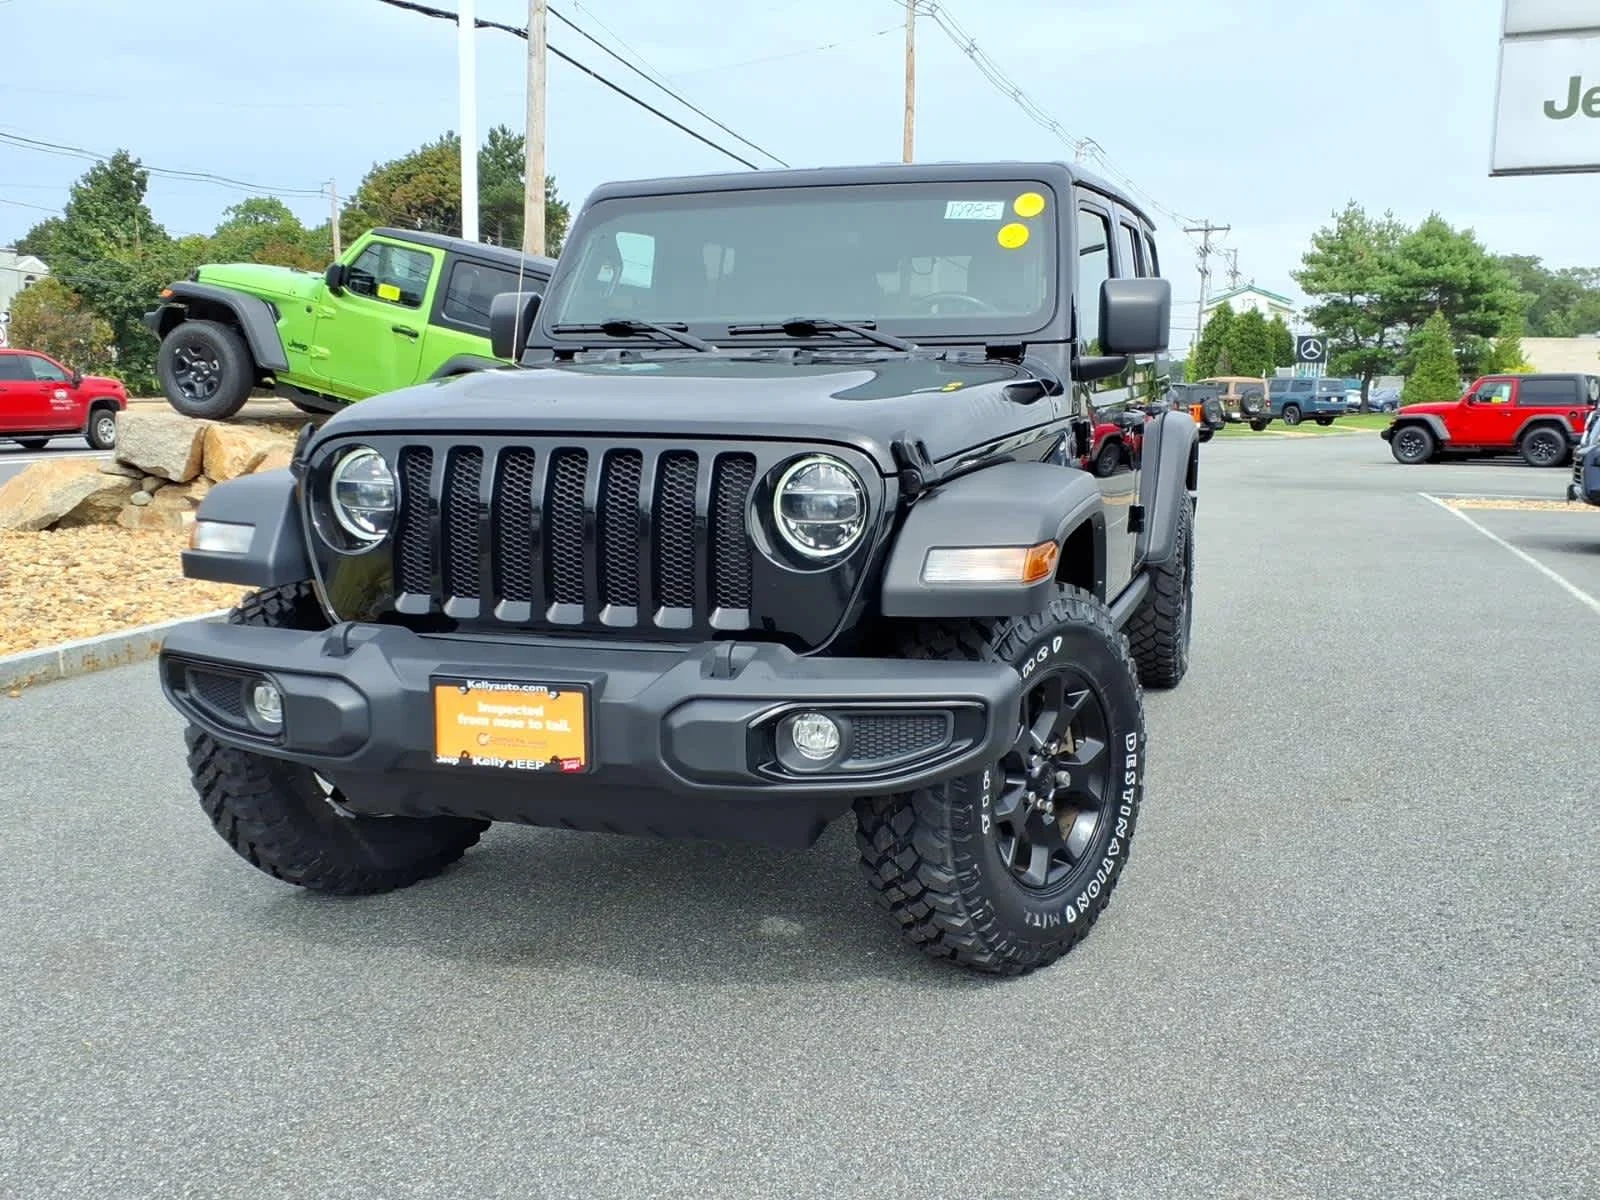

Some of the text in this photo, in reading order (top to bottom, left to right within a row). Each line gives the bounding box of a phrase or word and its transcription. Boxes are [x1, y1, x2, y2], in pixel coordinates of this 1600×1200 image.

[466, 680, 548, 693] Kellyauto.com
[477, 701, 544, 717] Inspected
[457, 712, 489, 726] from
[492, 718, 525, 729] nose
[527, 718, 543, 730] to
[436, 755, 460, 766] Jeep
[472, 756, 545, 770] Kelly JEEP
[1076, 732, 1137, 913] DESTINATION
